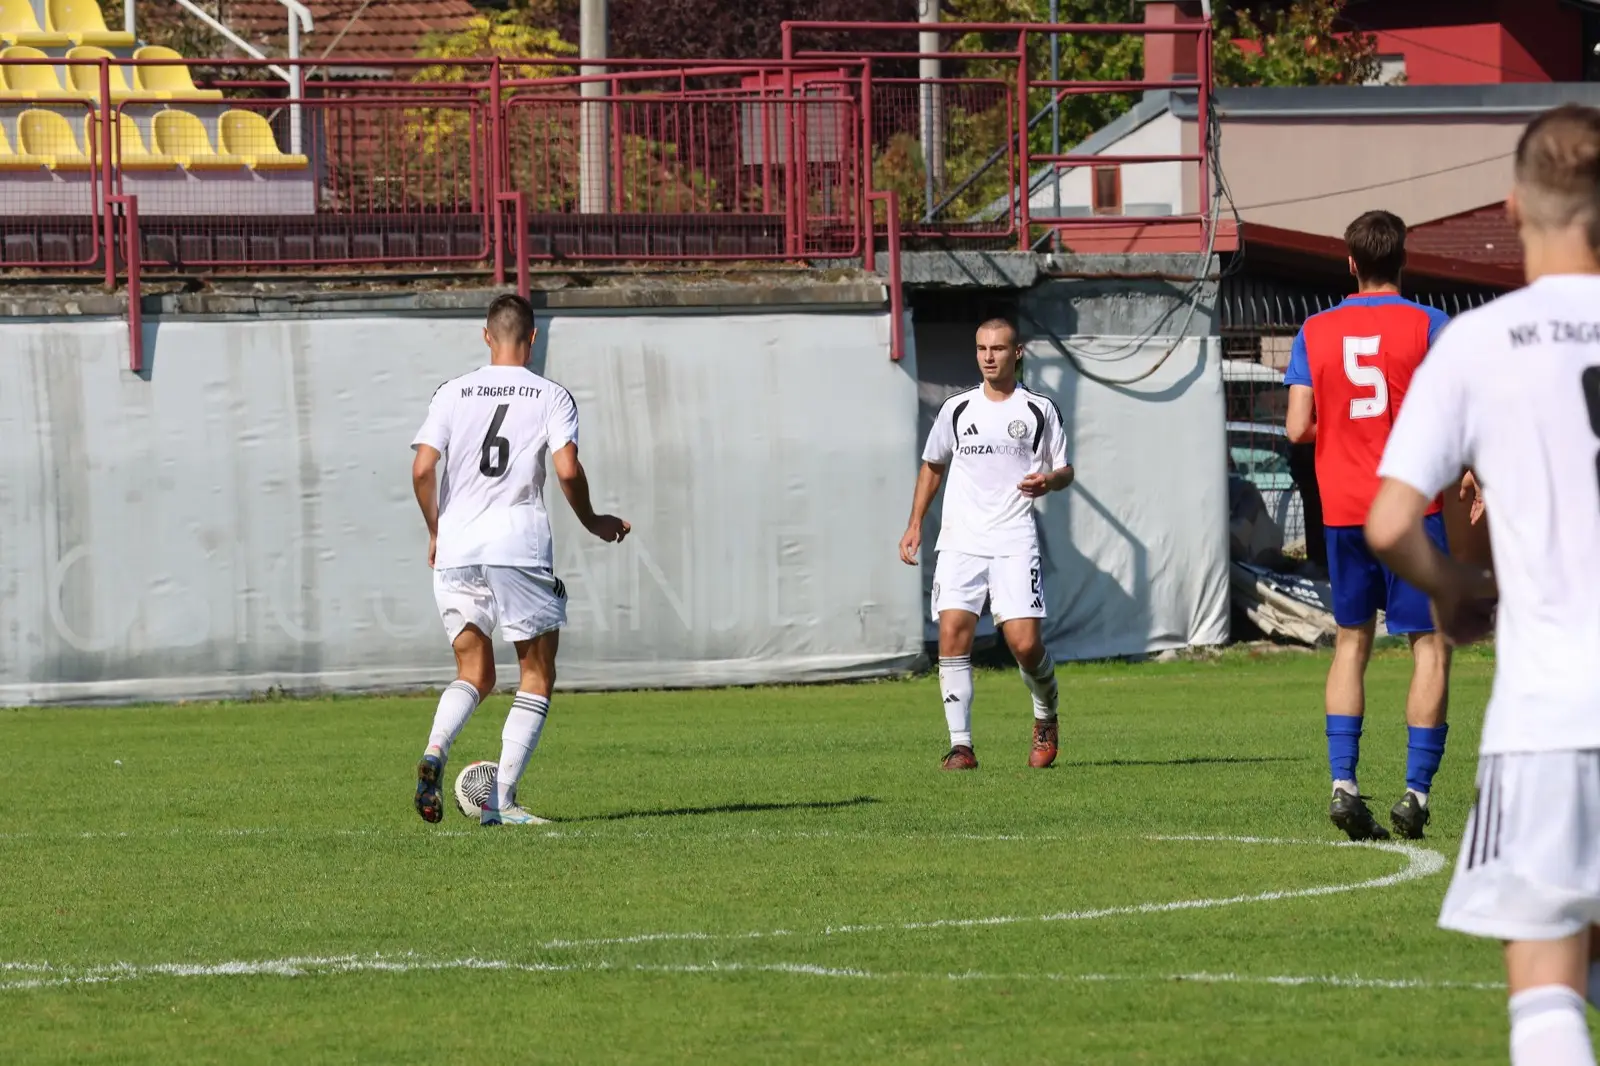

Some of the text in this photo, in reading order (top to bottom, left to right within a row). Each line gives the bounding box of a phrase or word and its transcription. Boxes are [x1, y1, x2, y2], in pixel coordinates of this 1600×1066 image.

[1508, 321, 1541, 348] NK
[1343, 334, 1388, 420] 5
[461, 386, 542, 399] NK ZAGREB CITY
[480, 404, 510, 477] 6
[1030, 568, 1039, 594] 2
